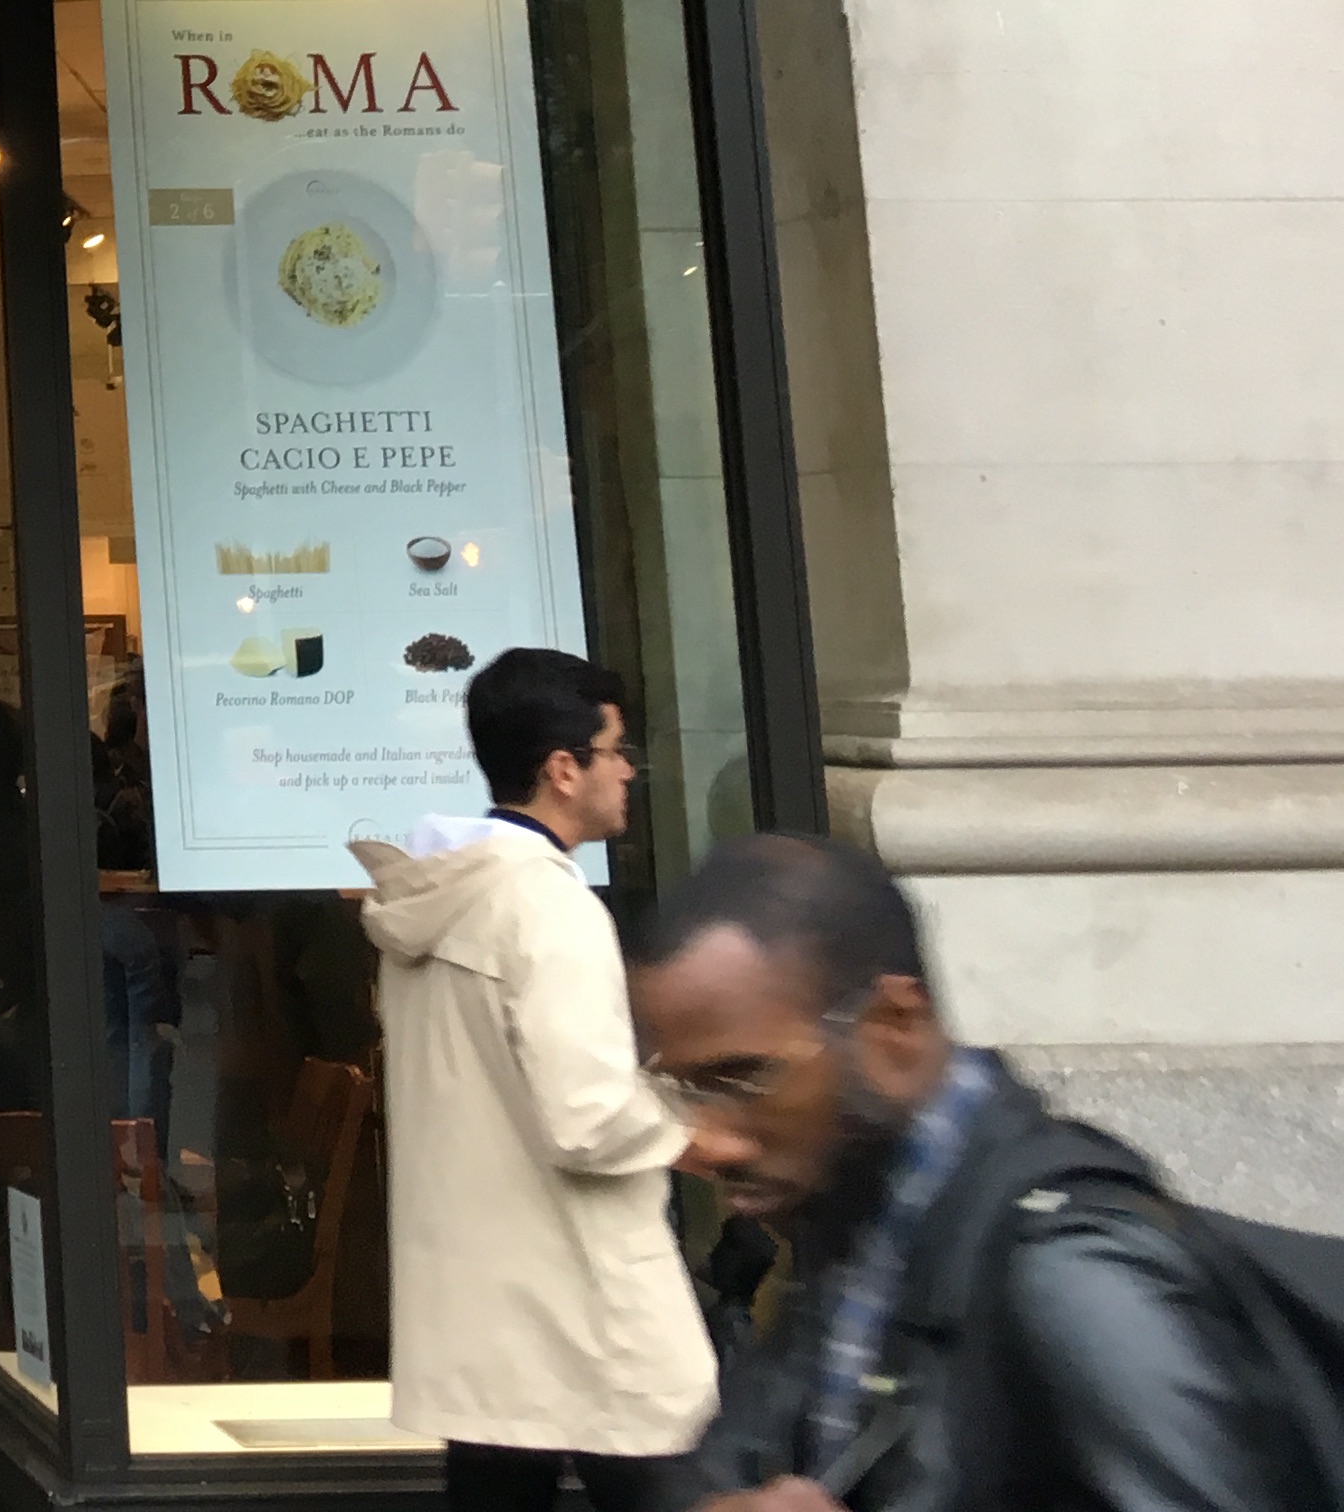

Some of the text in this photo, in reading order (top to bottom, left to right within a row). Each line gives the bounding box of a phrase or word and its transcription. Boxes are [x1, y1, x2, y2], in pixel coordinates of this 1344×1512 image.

[172, 30, 233, 42] When in
[333, 127, 350, 138] as
[354, 124, 378, 137] the
[382, 124, 442, 137] Romans
[446, 123, 466, 136] do
[169, 203, 180, 219] 2
[203, 203, 215, 220] 6
[256, 410, 433, 435] SPAGHETTI
[240, 445, 457, 471] CACIO E PEPE
[233, 479, 467, 500] Spaghetti with Cheese and Black Pepper
[247, 584, 304, 604] Spaghetti
[408, 582, 459, 598] Sea Salt
[215, 690, 355, 707] Pecorino Romano DOP
[404, 689, 438, 704] Black
[251, 748, 283, 766] Shop
[285, 748, 352, 763] housemade
[355, 748, 378, 761] and
[381, 747, 422, 761] Italian
[279, 772, 303, 788] and
[304, 772, 330, 791] pick
[332, 775, 349, 792] up
[351, 777, 360, 787] a
[362, 774, 398, 790] recipe
[400, 771, 428, 786] card
